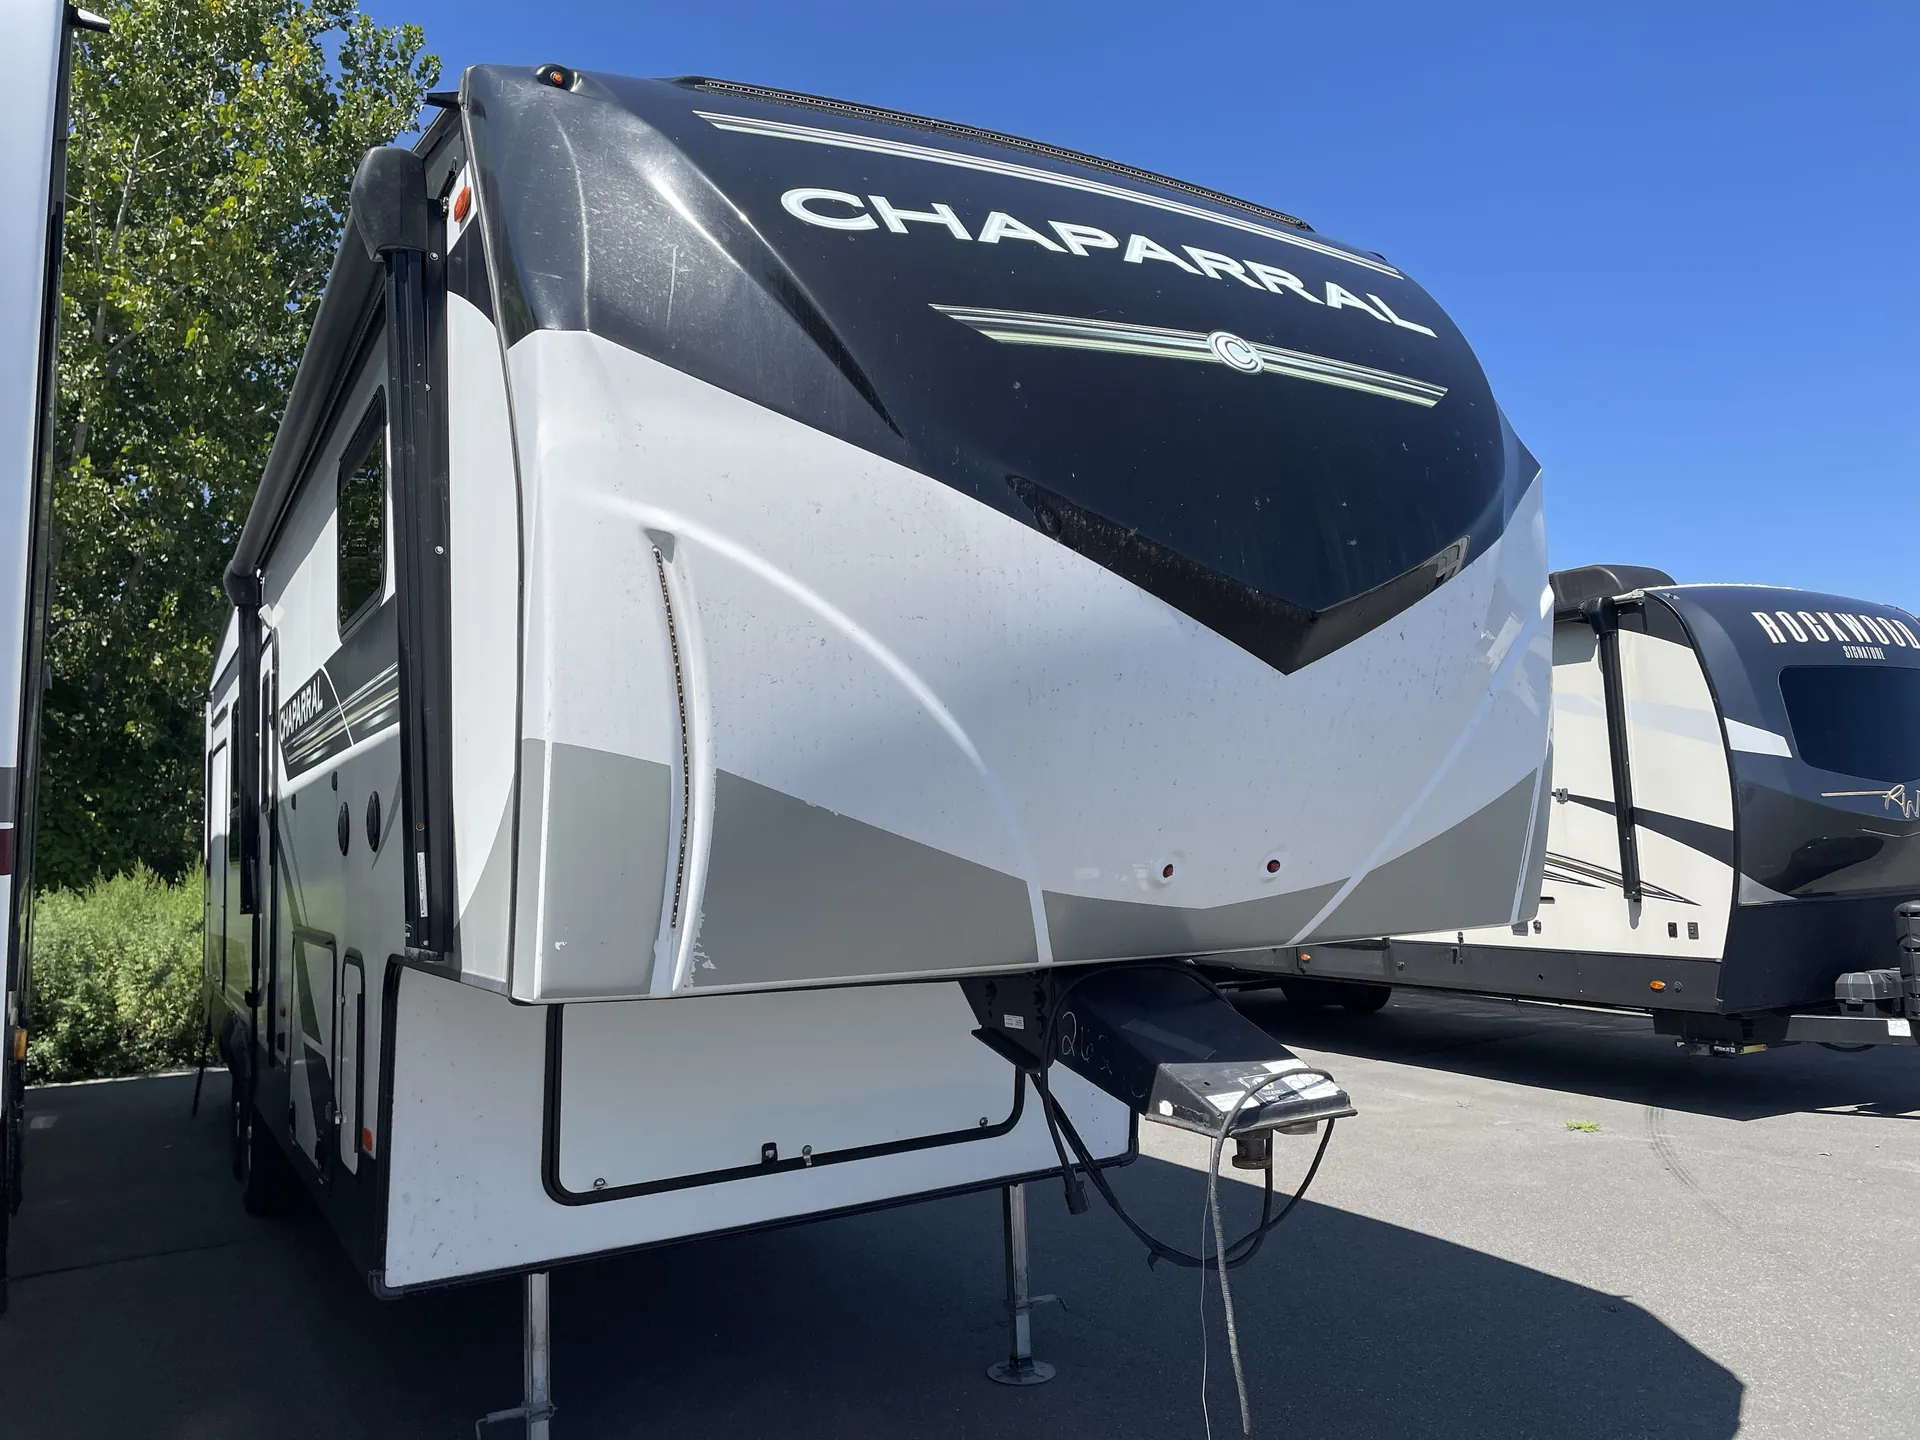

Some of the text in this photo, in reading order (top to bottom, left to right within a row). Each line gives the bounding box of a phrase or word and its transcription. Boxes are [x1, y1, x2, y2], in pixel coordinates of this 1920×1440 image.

[781, 187, 1437, 338] CHAPARRAL
[1751, 611, 1920, 650] ROCKWOOD
[1843, 645, 1887, 660] SIGNATURE
[280, 675, 323, 744] CHAPARRAL
